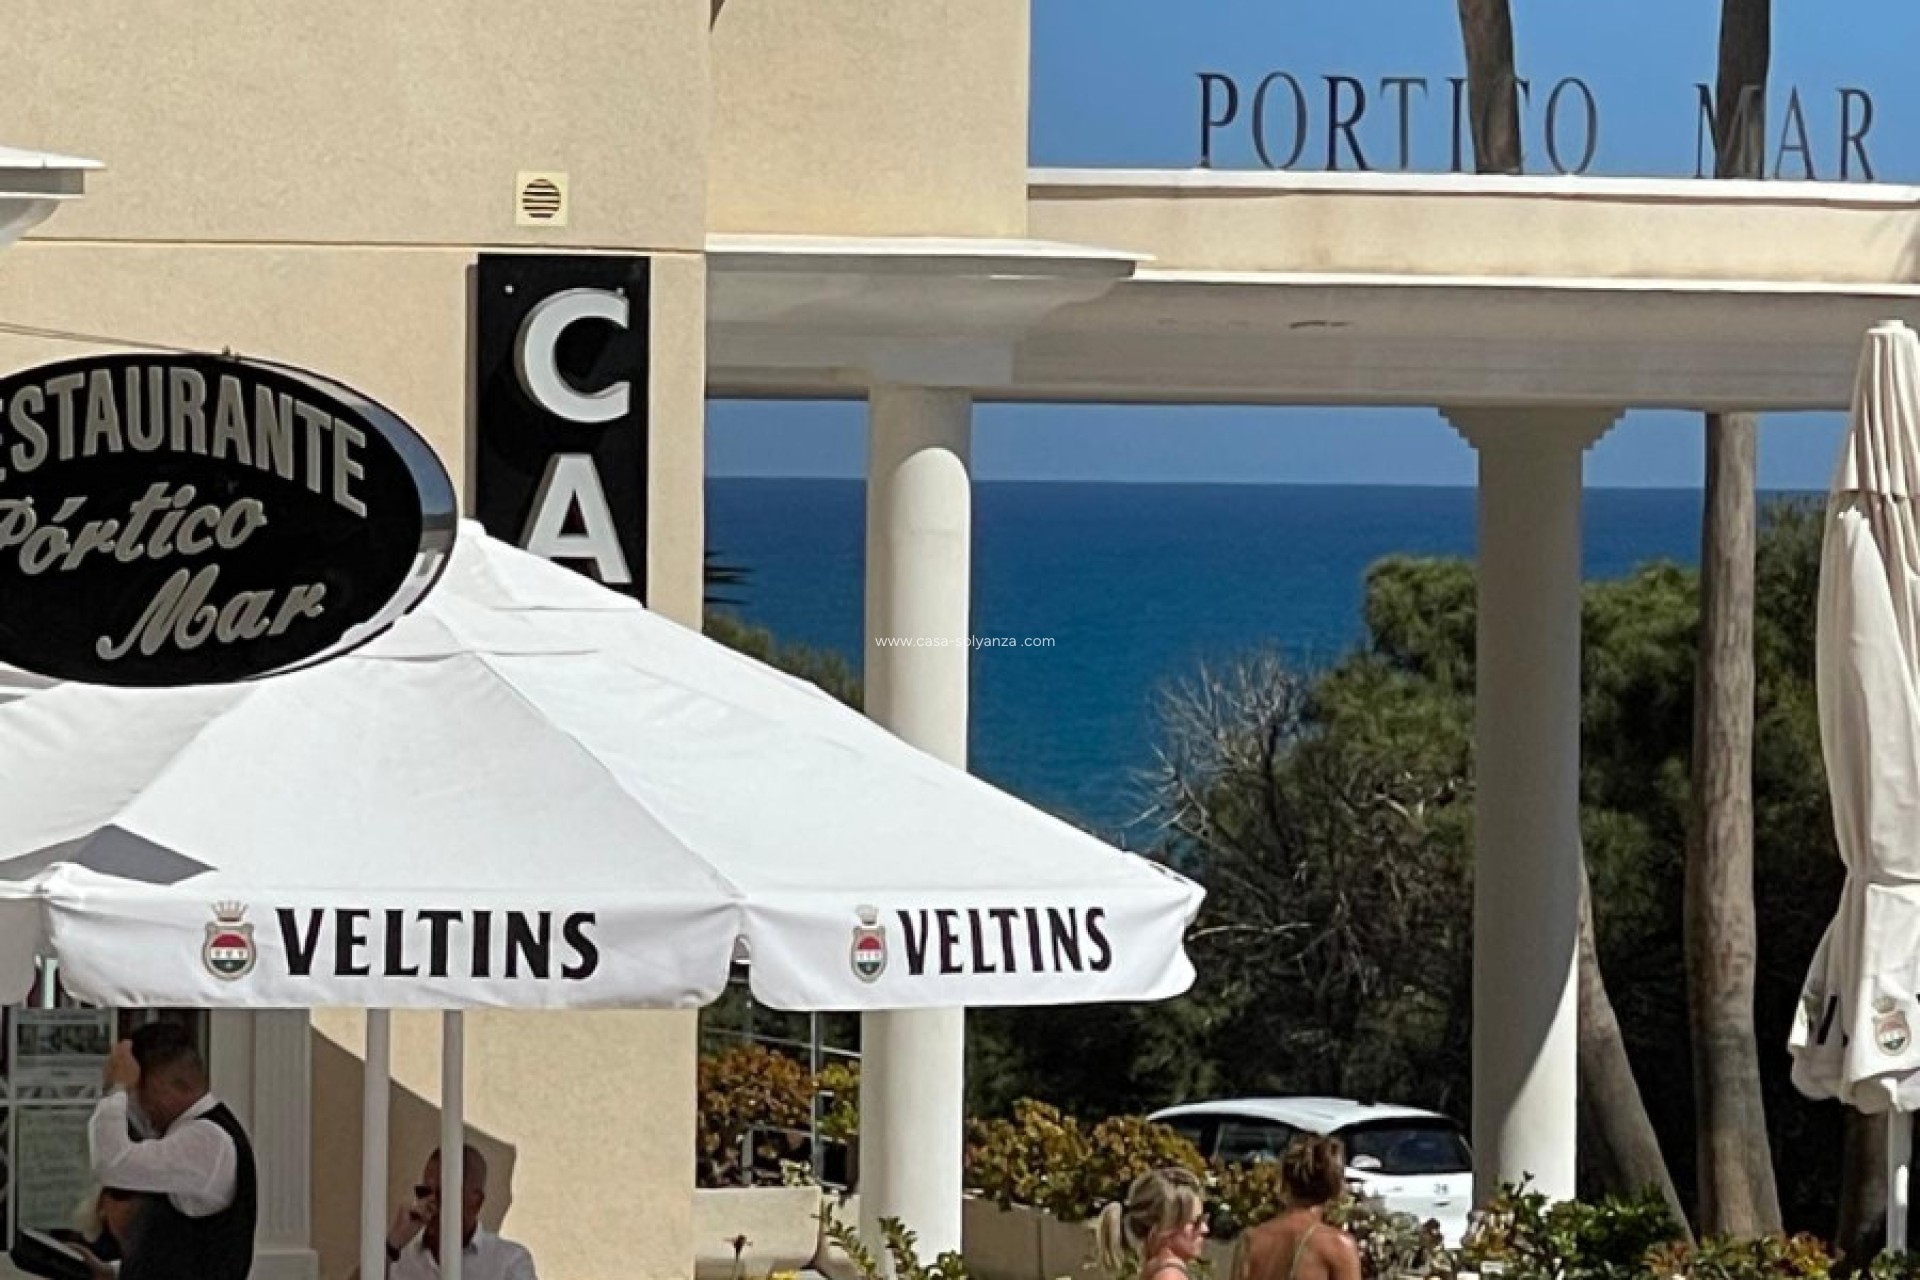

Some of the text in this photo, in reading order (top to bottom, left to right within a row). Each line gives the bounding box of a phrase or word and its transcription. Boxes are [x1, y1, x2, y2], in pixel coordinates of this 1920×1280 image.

[1196, 71, 1875, 180] PORTIO MAR
[0, 366, 367, 518] STAURANTE
[96, 563, 327, 661] Mar
[275, 907, 600, 980] VELTINS
[895, 906, 1112, 976] VELTINS
